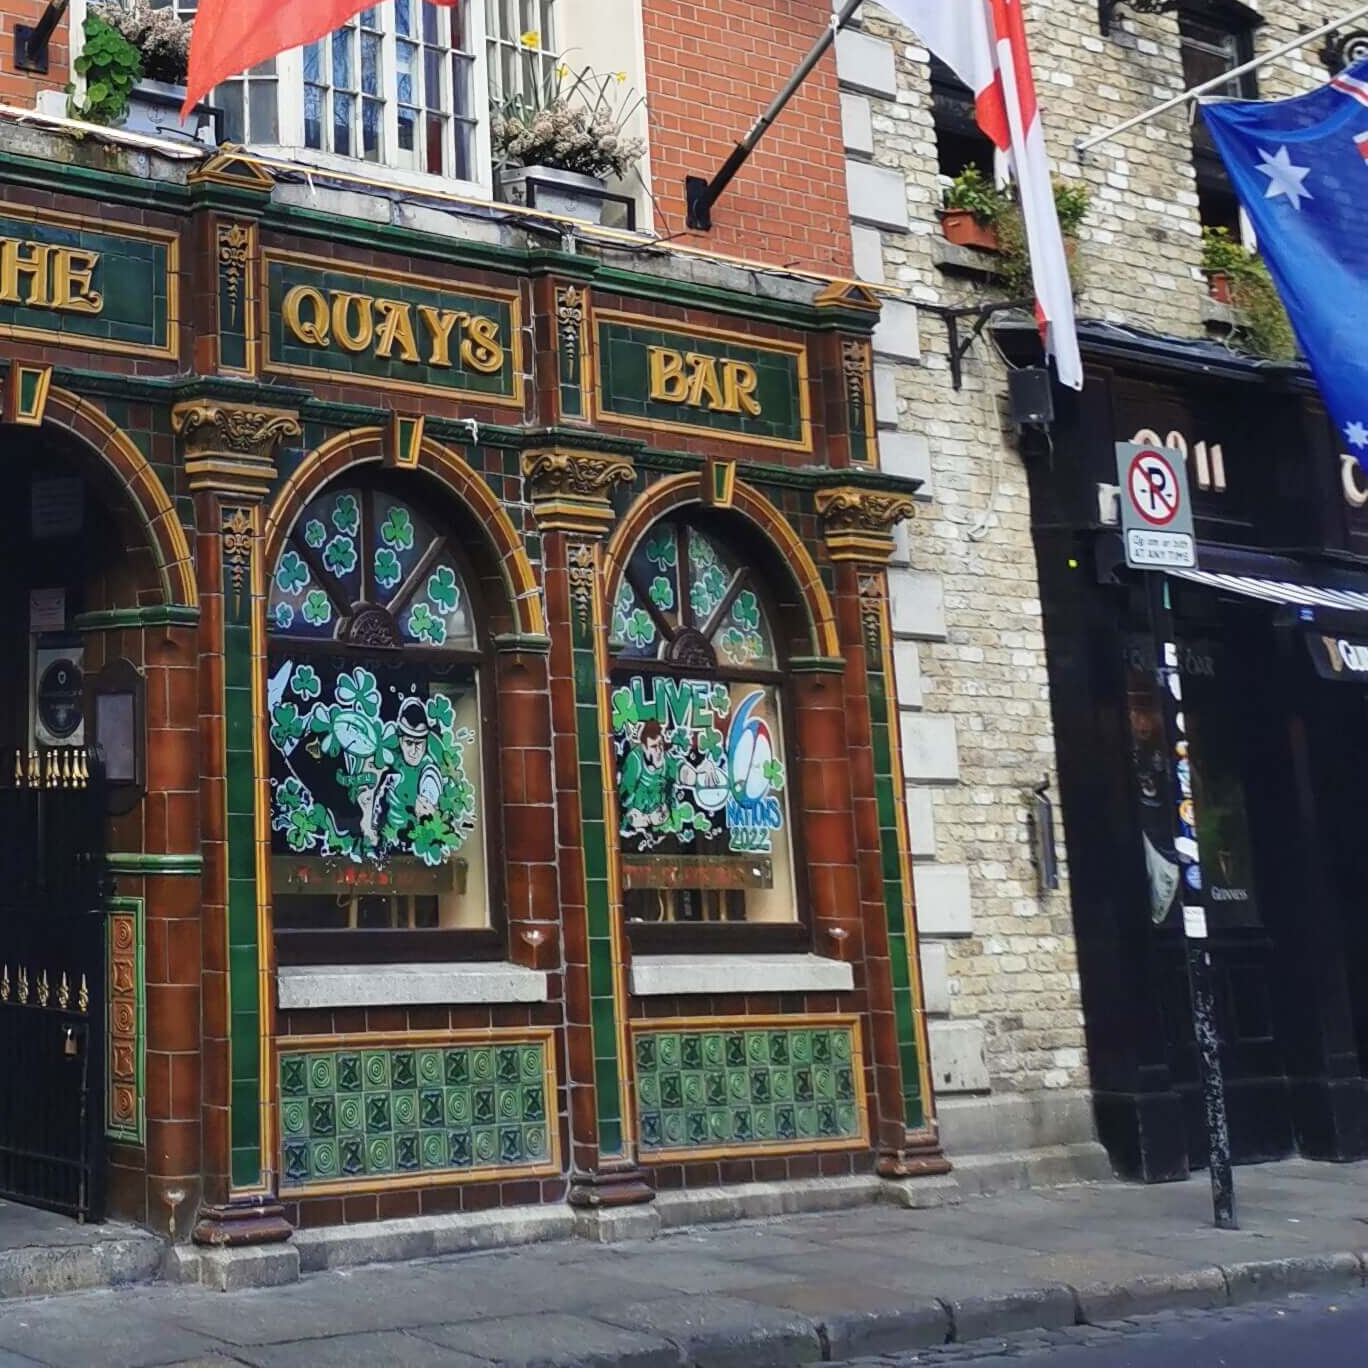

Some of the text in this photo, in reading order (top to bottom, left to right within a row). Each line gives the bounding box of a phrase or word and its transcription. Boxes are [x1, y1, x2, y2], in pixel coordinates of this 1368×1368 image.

[647, 344, 762, 416] BAR
[631, 677, 714, 728] LIVE
[727, 798, 782, 829] NATIONS
[730, 828, 770, 851] 2022
